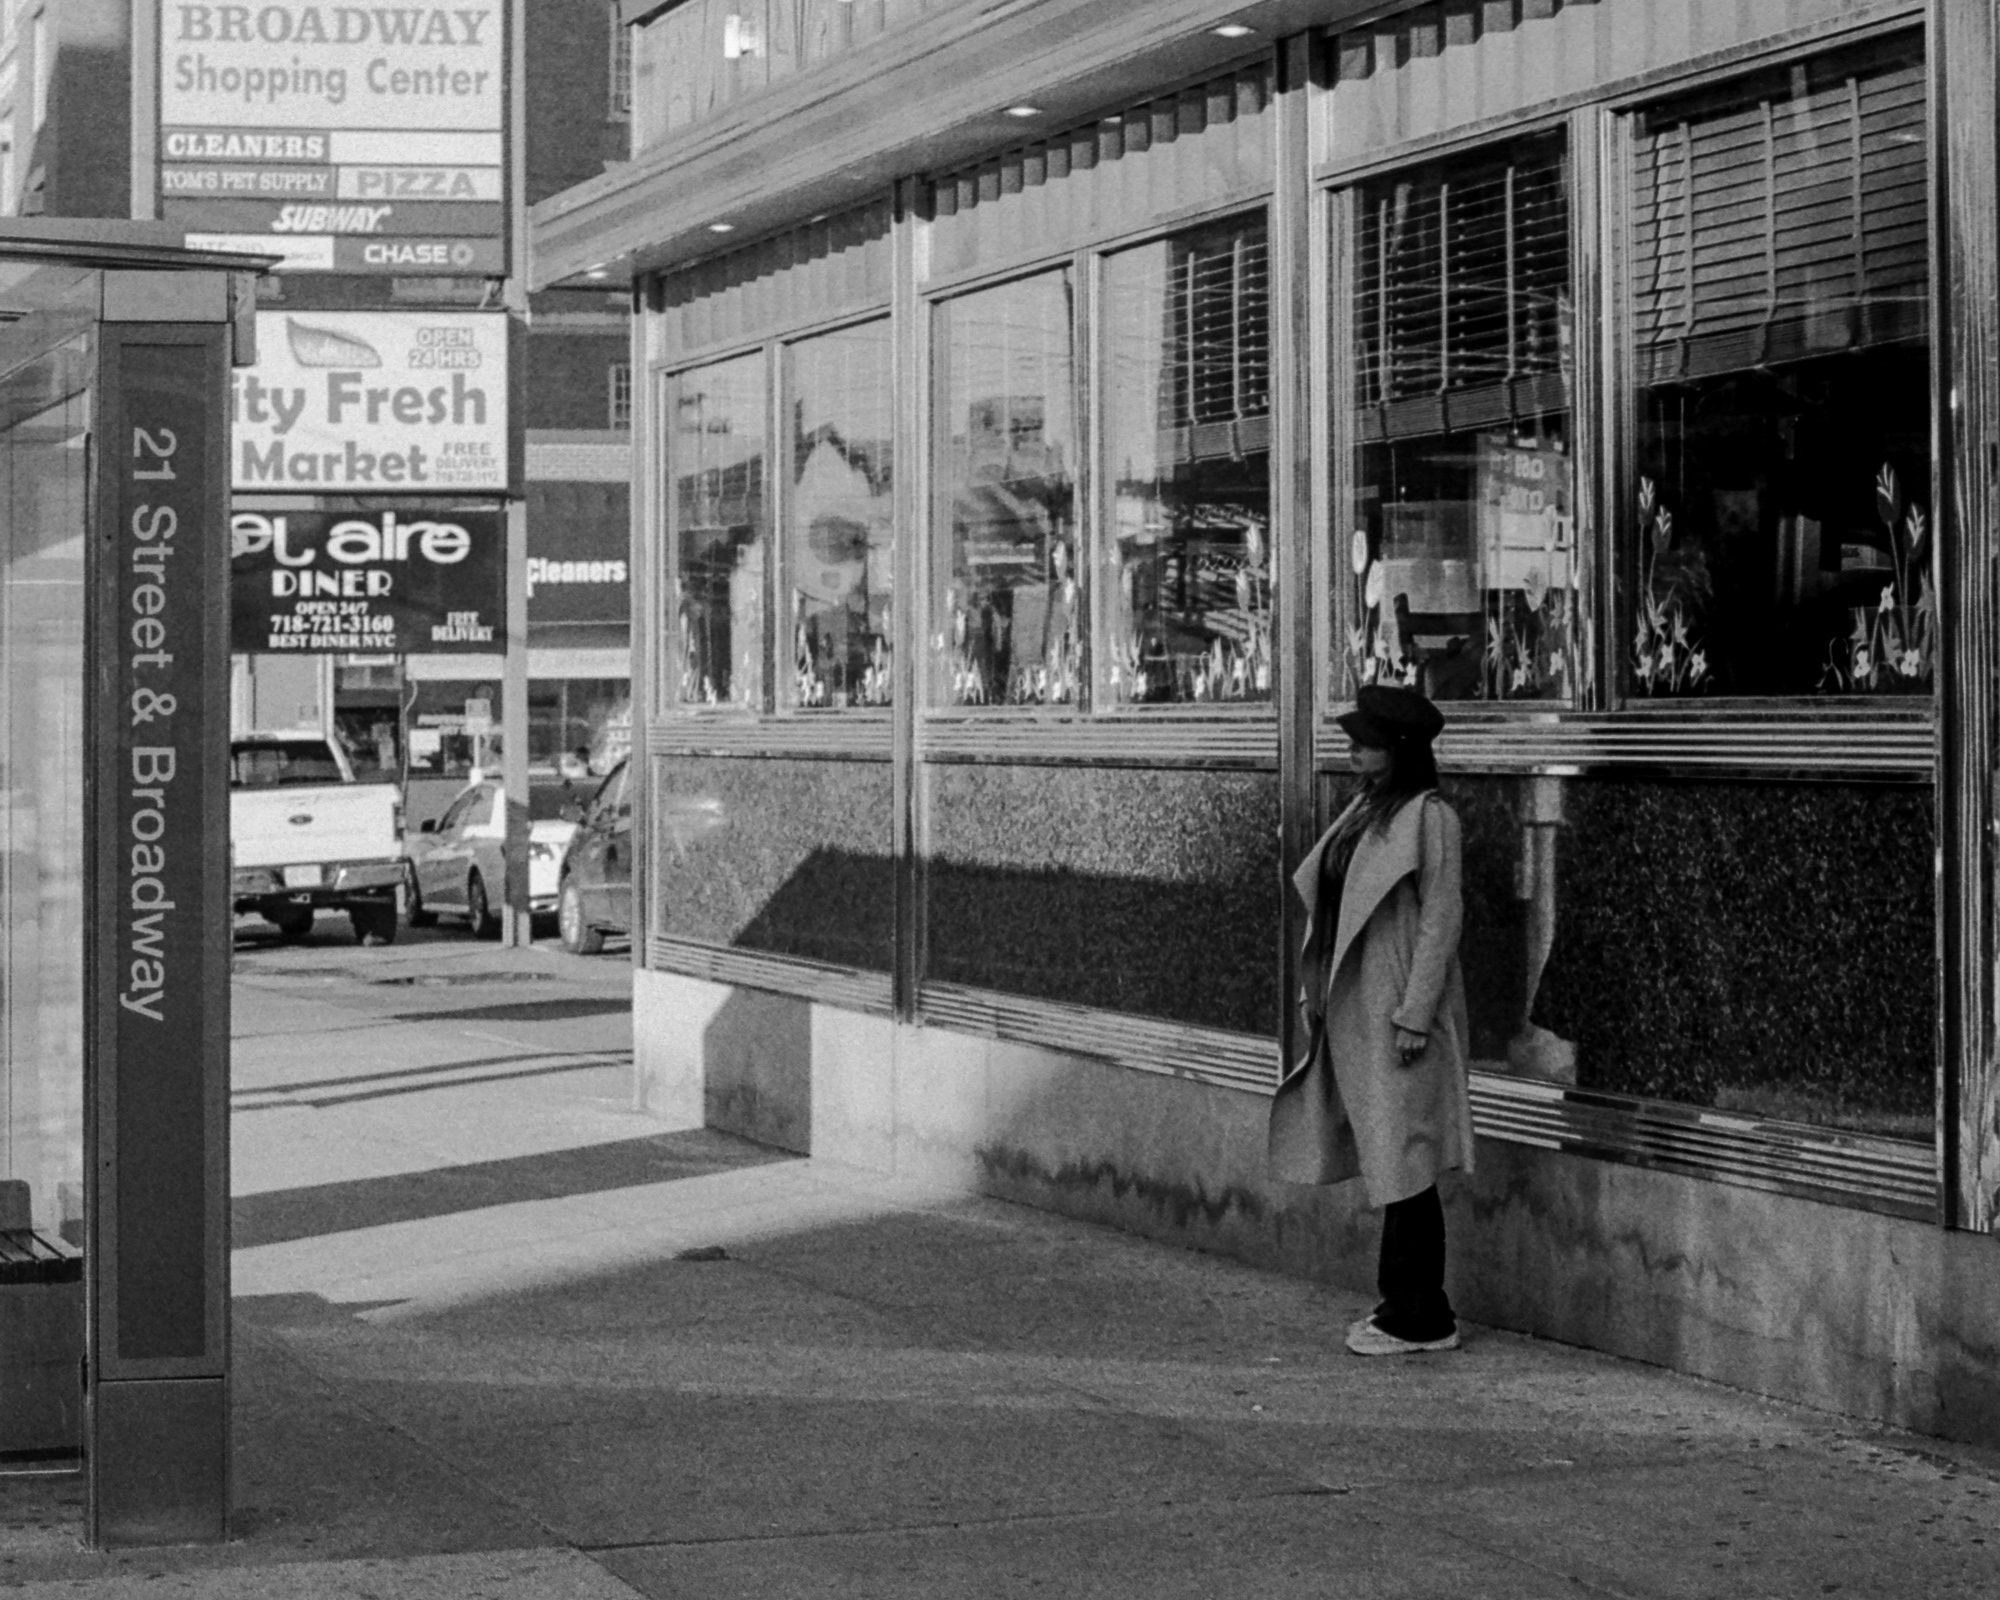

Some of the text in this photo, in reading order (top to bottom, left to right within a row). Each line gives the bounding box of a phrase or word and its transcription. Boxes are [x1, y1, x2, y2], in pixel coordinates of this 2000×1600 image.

[177, 4, 490, 46] BROADWAY
[175, 54, 489, 105] Shopping Center
[167, 133, 324, 159] CLEANERS
[221, 171, 257, 190] PET
[259, 172, 329, 192] SUPPLY
[357, 171, 477, 197] PIZZA
[272, 205, 392, 232] SUBWAY
[364, 245, 448, 264] CHASE
[417, 327, 474, 347] OPEN
[408, 348, 482, 369] 24 HRS
[327, 371, 486, 425] Fresh
[241, 440, 428, 482] Market
[442, 442, 492, 455] FREE
[271, 569, 393, 597] DINER
[295, 601, 369, 615] OPEN 24/7
[270, 614, 395, 633] 718-721-3160
[268, 634, 397, 648] BEST DINER NYC
[119, 428, 177, 1022] 21 Street & Broadway
